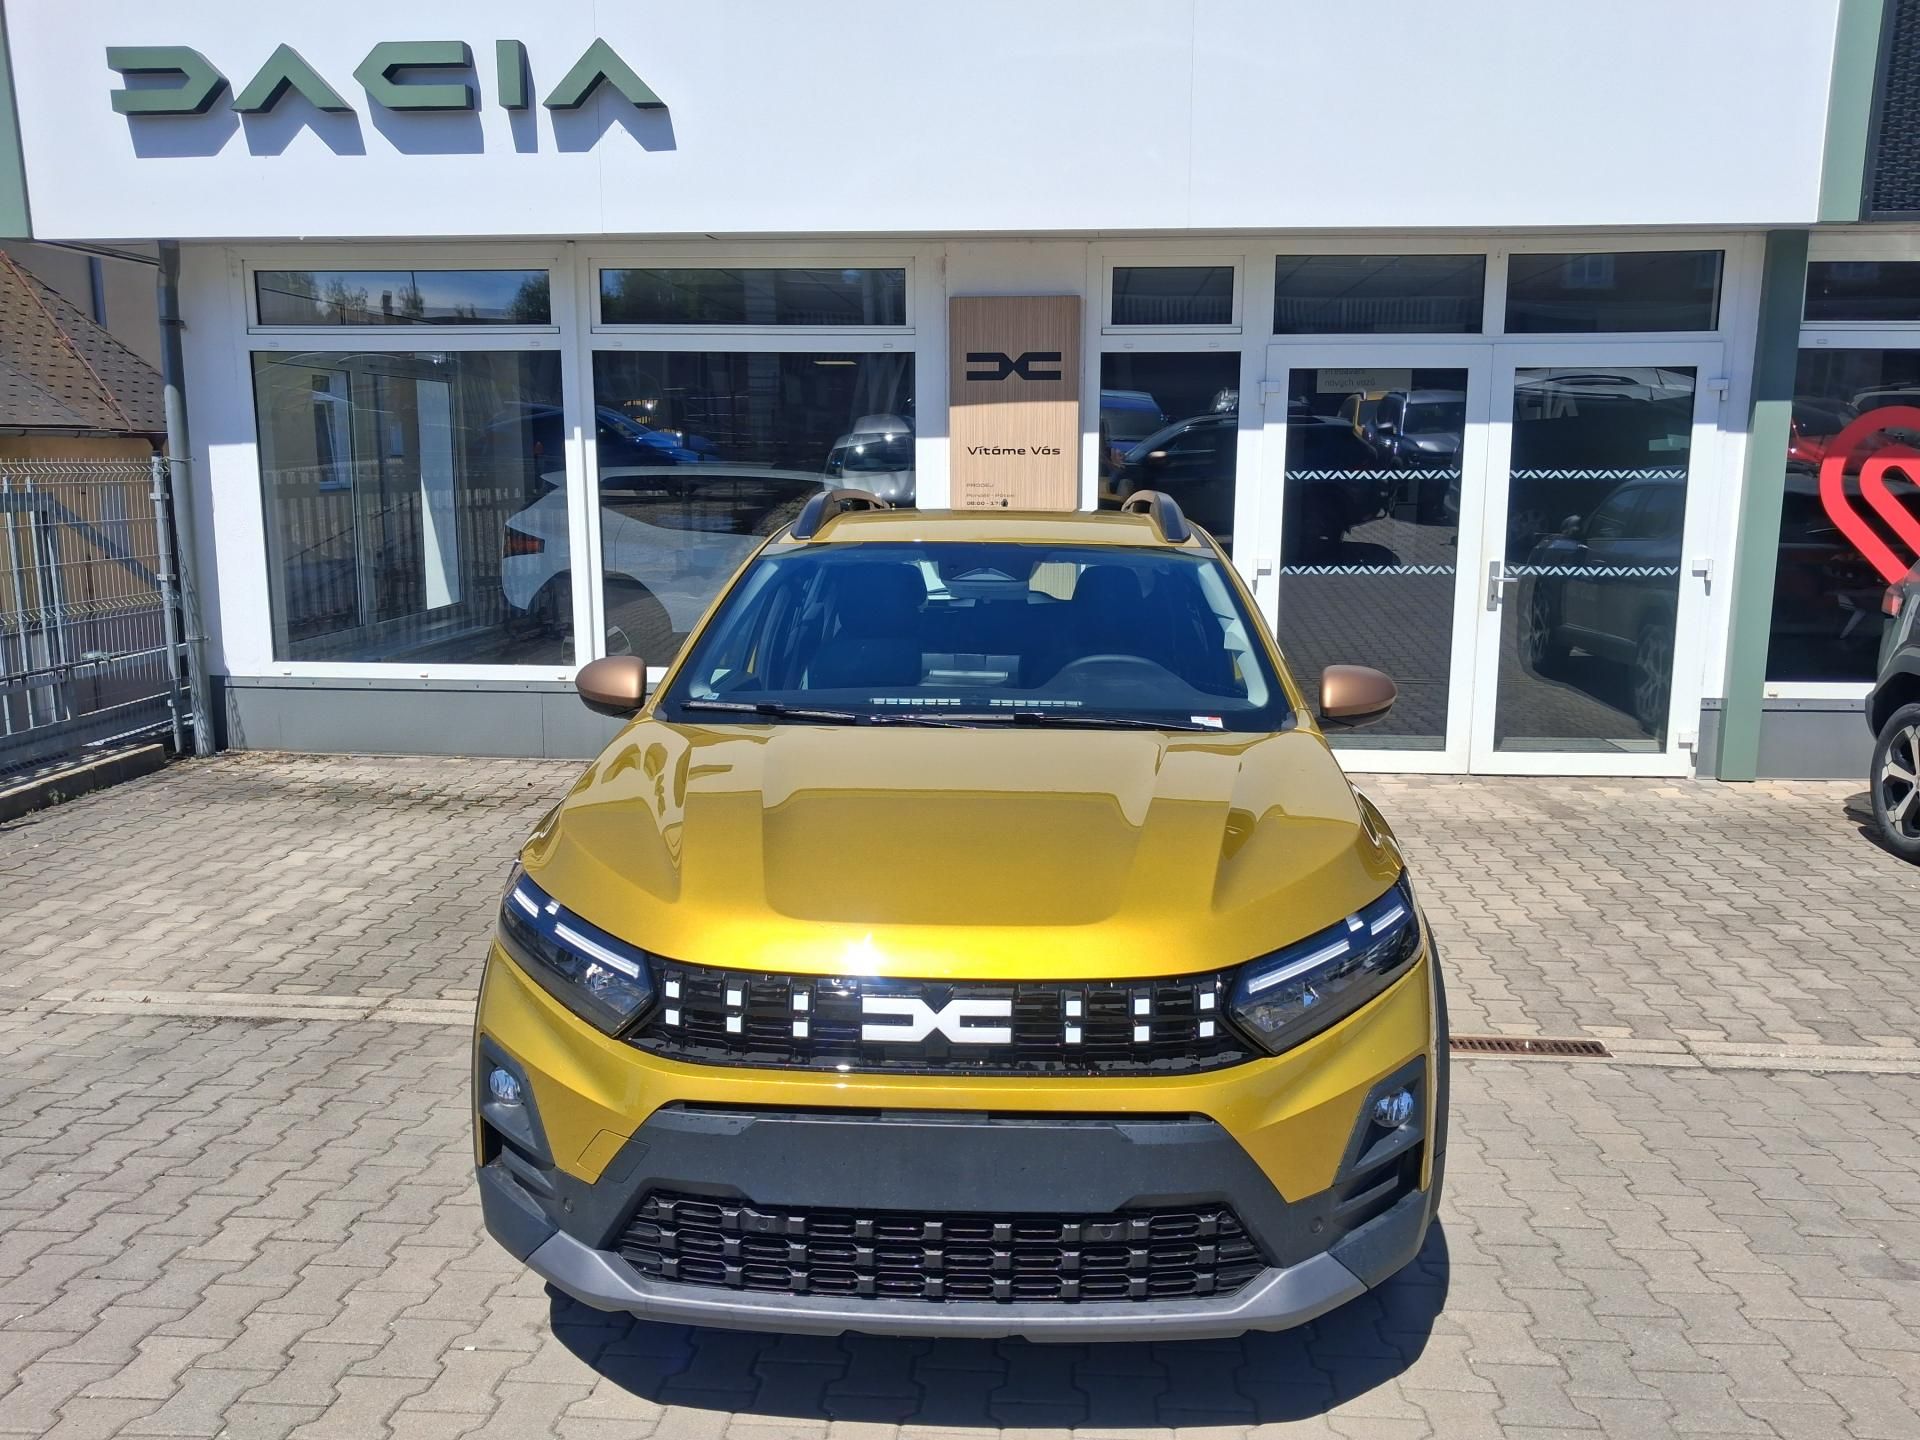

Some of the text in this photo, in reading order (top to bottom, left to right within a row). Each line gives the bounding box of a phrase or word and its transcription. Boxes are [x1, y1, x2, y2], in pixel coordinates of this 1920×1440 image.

[106, 37, 669, 115] DACIA
[967, 446, 1061, 455] Vítáme Vás
